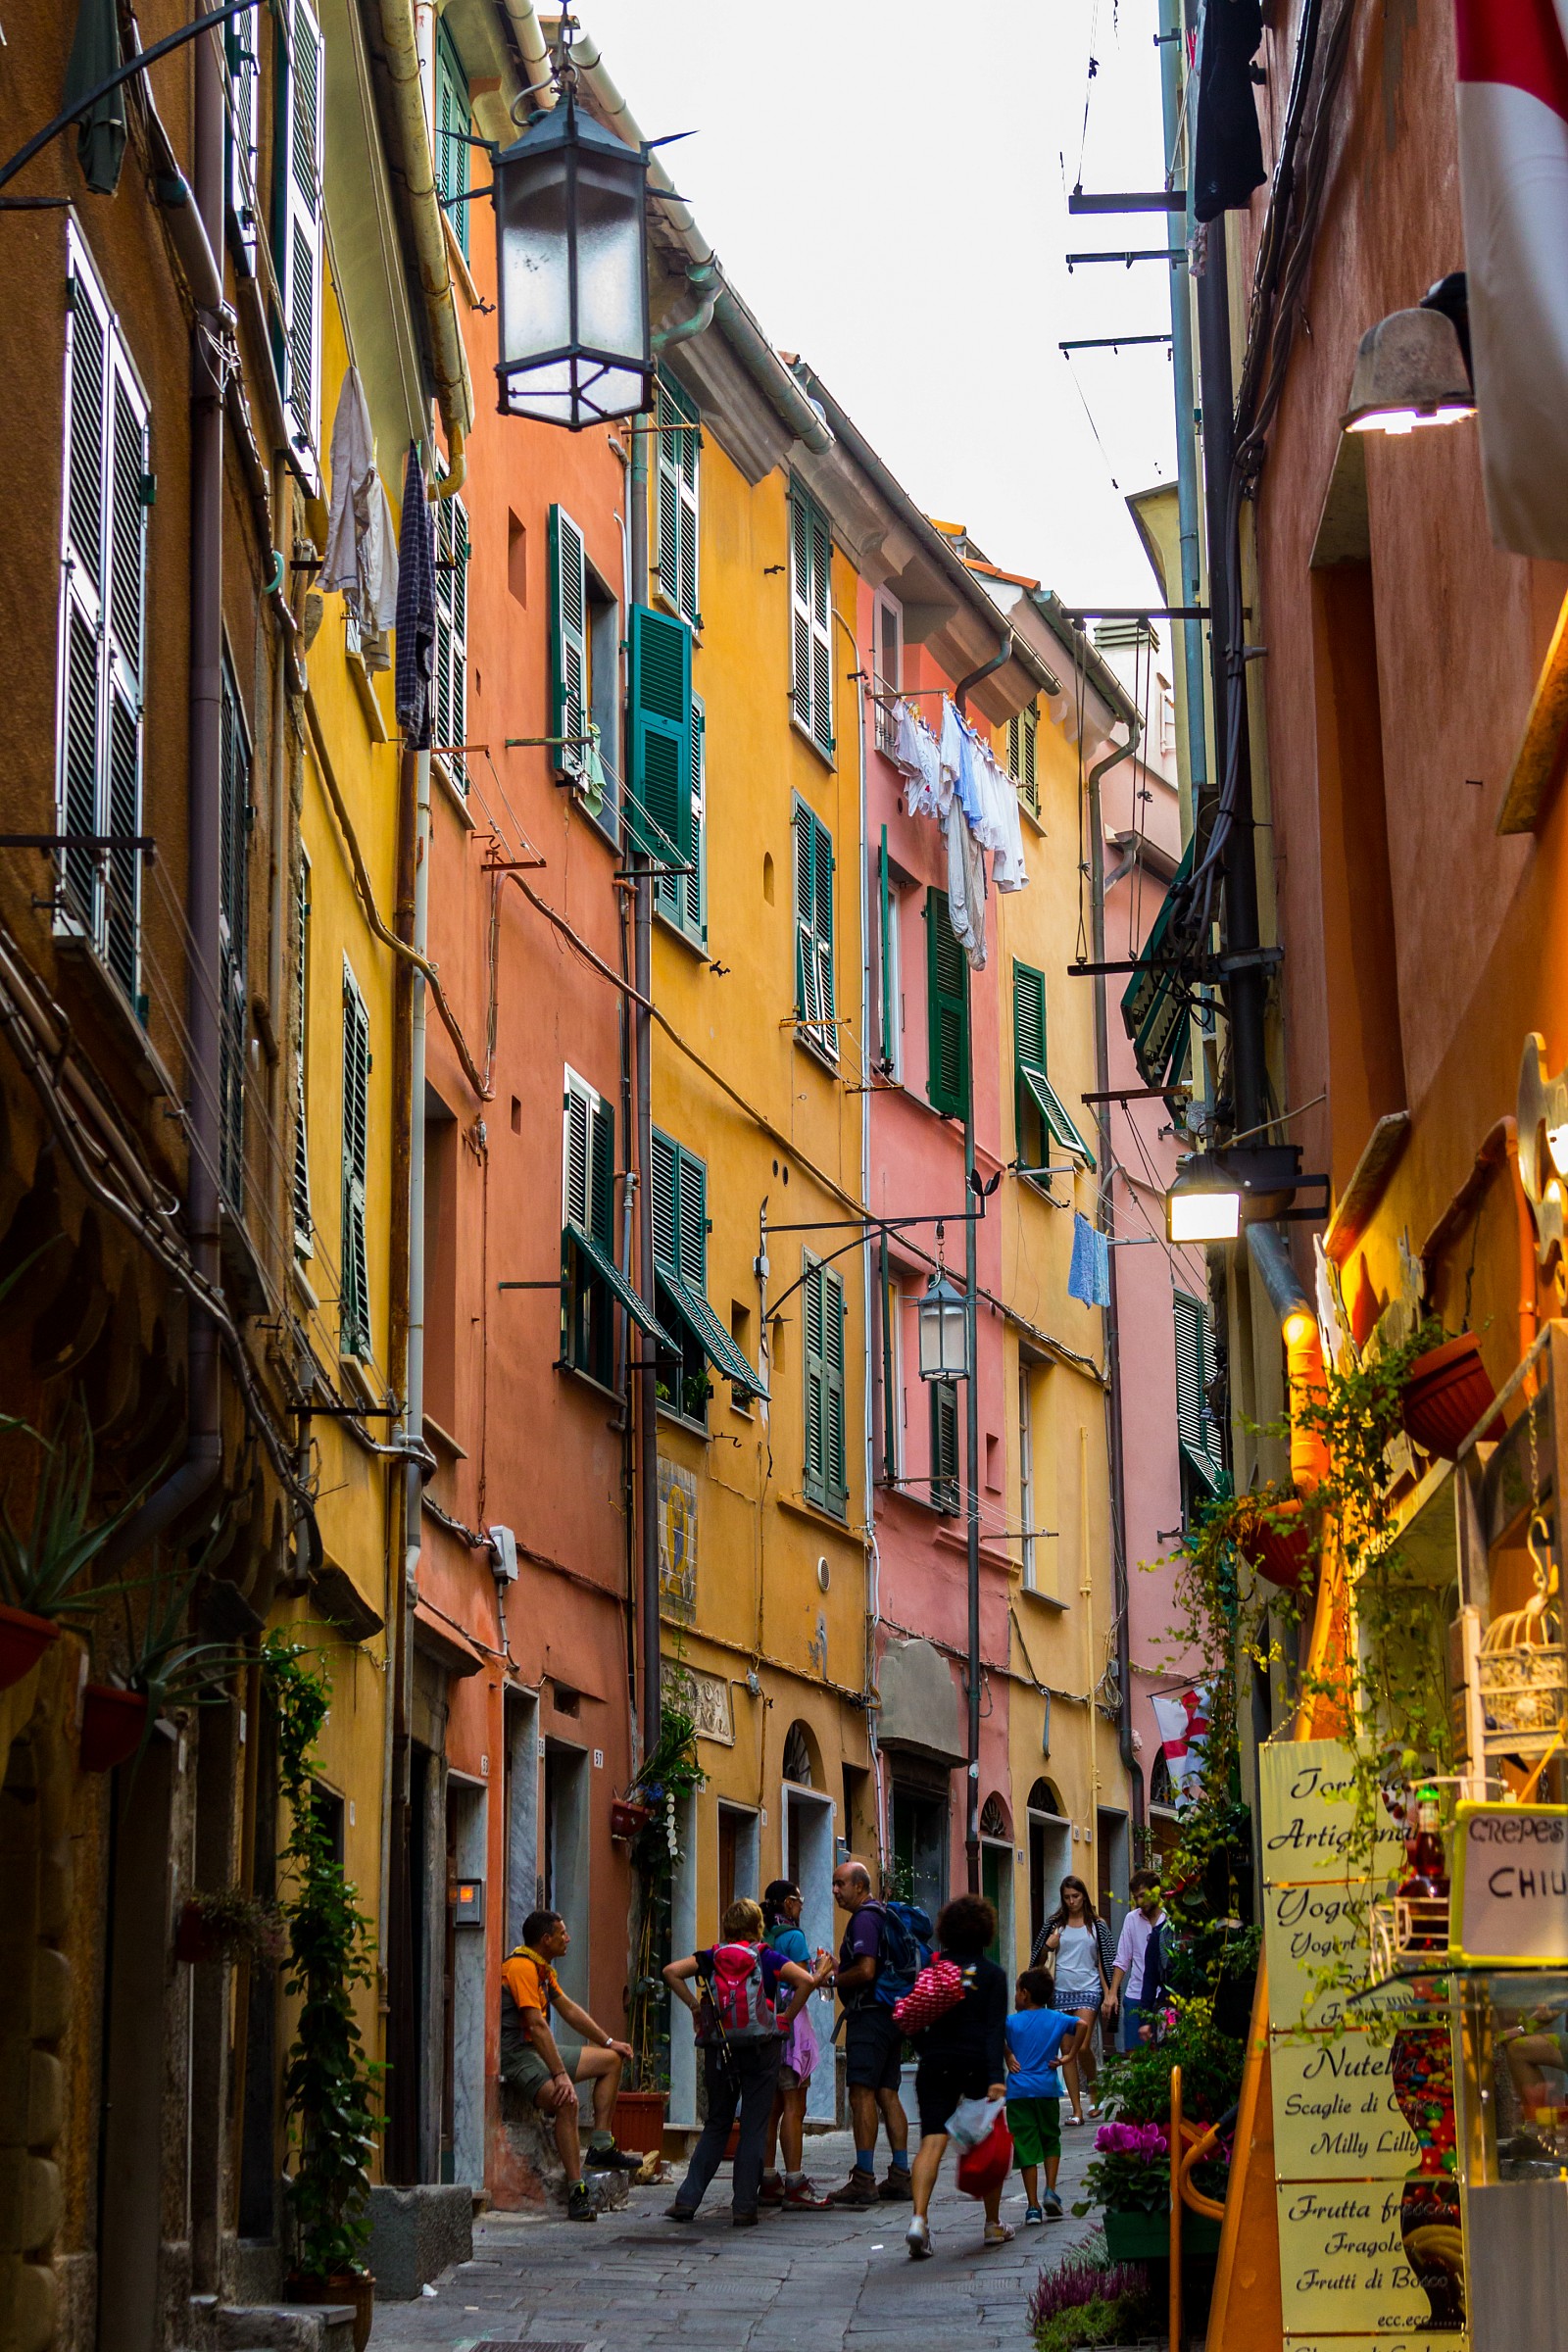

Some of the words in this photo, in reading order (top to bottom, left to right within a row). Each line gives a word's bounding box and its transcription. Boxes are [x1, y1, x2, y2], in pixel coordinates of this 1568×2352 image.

[595, 1751, 603, 1766] 57
[1488, 1866, 1566, 1898] CHIU
[1302, 2045, 1418, 2080] Nutella
[1285, 2093, 1351, 2119] Scaglie
[1360, 2091, 1379, 2113] di
[1310, 2132, 1368, 2158] Milly
[1376, 2130, 1421, 2156] Lilly
[1288, 2194, 1370, 2222] Frutta
[1381, 2192, 1451, 2223] fresca
[1325, 2231, 1402, 2258] Fragole
[1297, 2268, 1356, 2292] Frutti
[1364, 2268, 1384, 2290] di
[1392, 2266, 1448, 2289] Bosco
